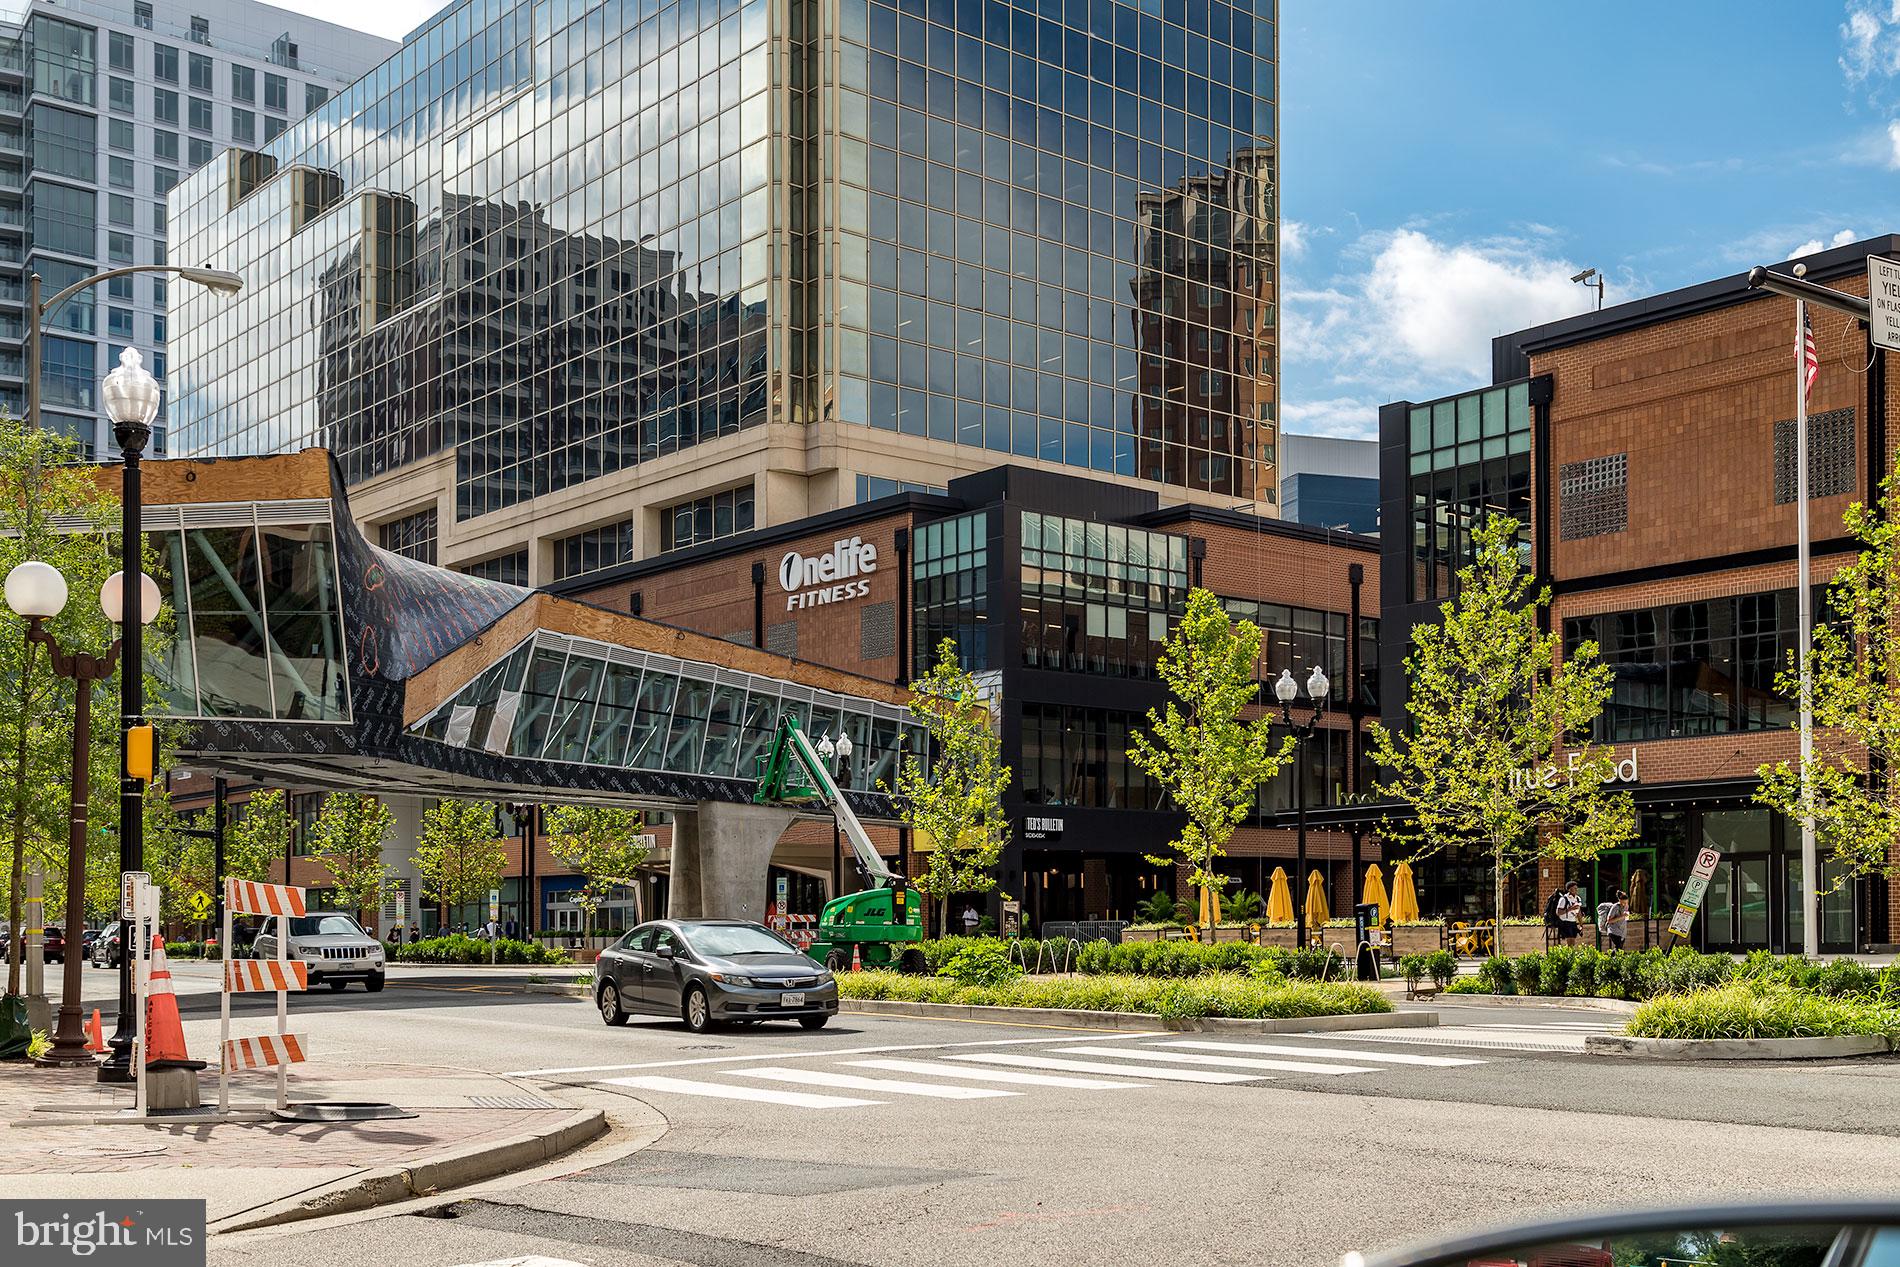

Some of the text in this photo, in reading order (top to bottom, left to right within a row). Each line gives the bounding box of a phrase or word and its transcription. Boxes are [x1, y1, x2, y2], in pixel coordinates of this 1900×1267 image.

[1879, 264, 1893, 279] LEFT
[1877, 298, 1886, 309] ON
[779, 536, 876, 591] Onelife
[786, 580, 870, 611] FITNESS
[273, 730, 295, 752] GRACE
[302, 730, 325, 753] GRACE
[334, 726, 356, 749] GRACE
[1042, 818, 1064, 831] BULLETIN
[864, 908, 886, 917] JLG
